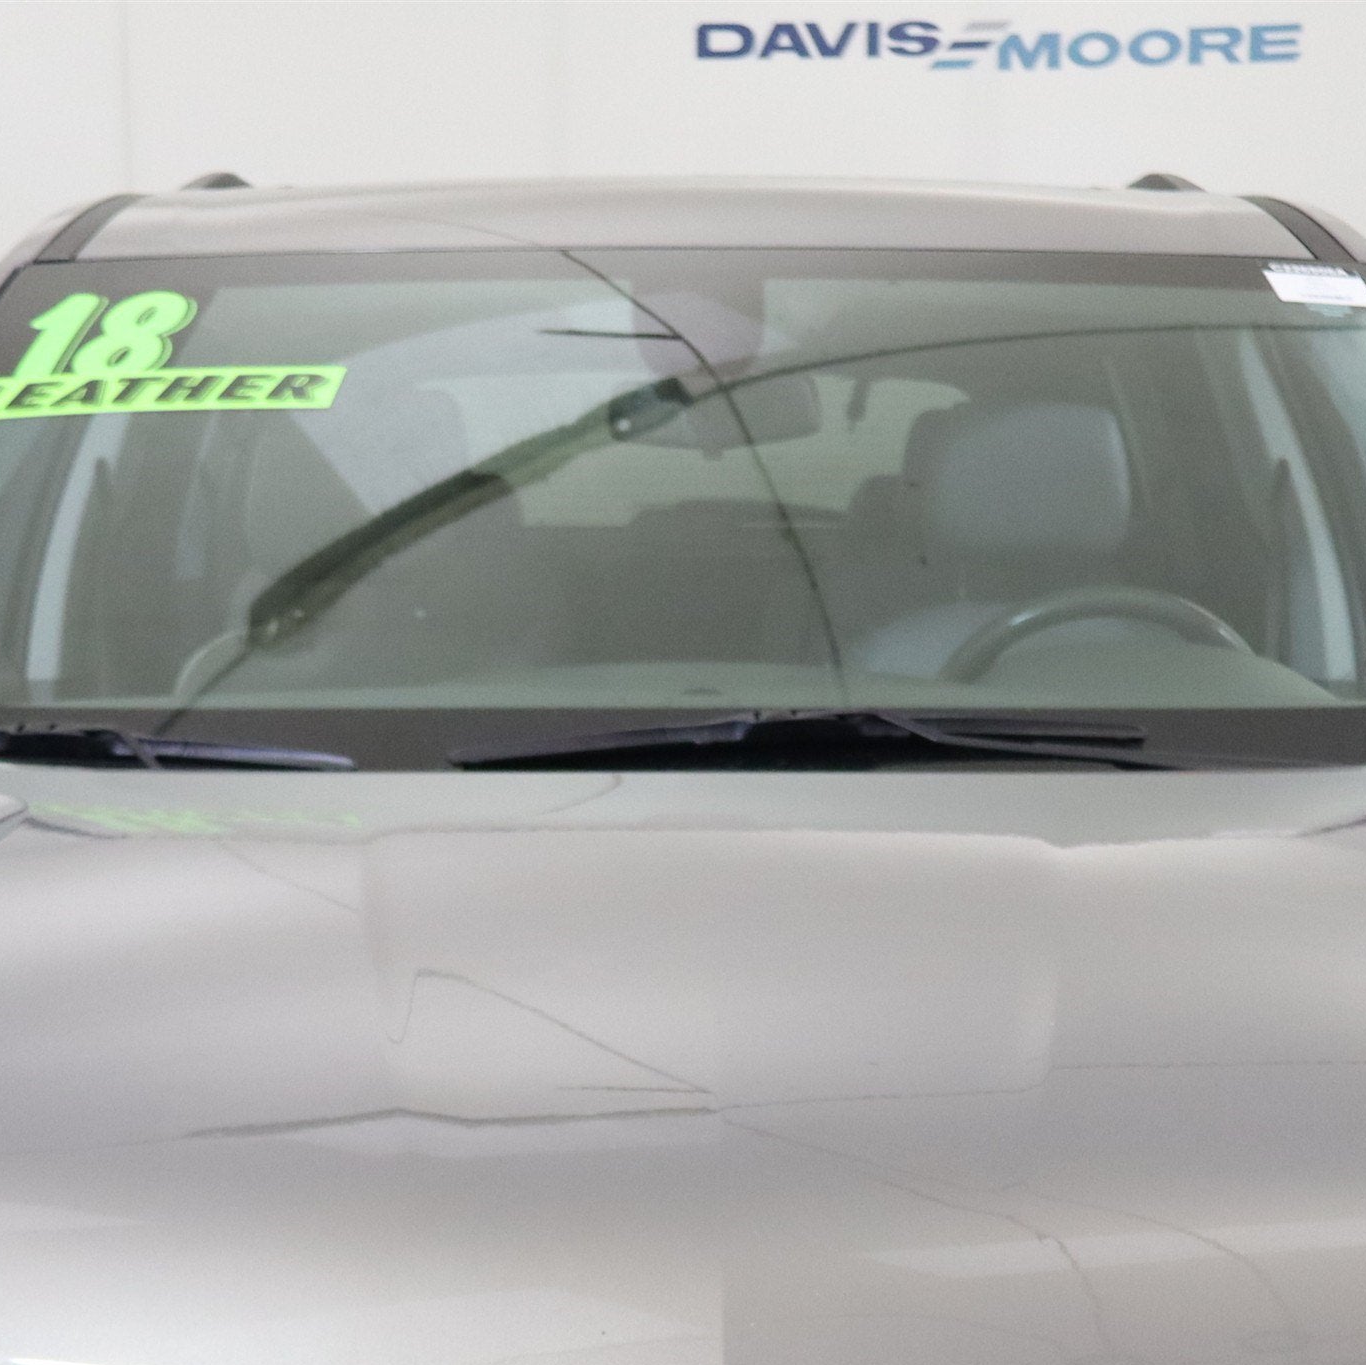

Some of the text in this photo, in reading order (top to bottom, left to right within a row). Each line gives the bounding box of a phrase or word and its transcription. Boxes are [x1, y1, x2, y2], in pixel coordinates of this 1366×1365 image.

[696, 21, 1303, 71] DAVIS MOORE
[13, 290, 198, 377] 18
